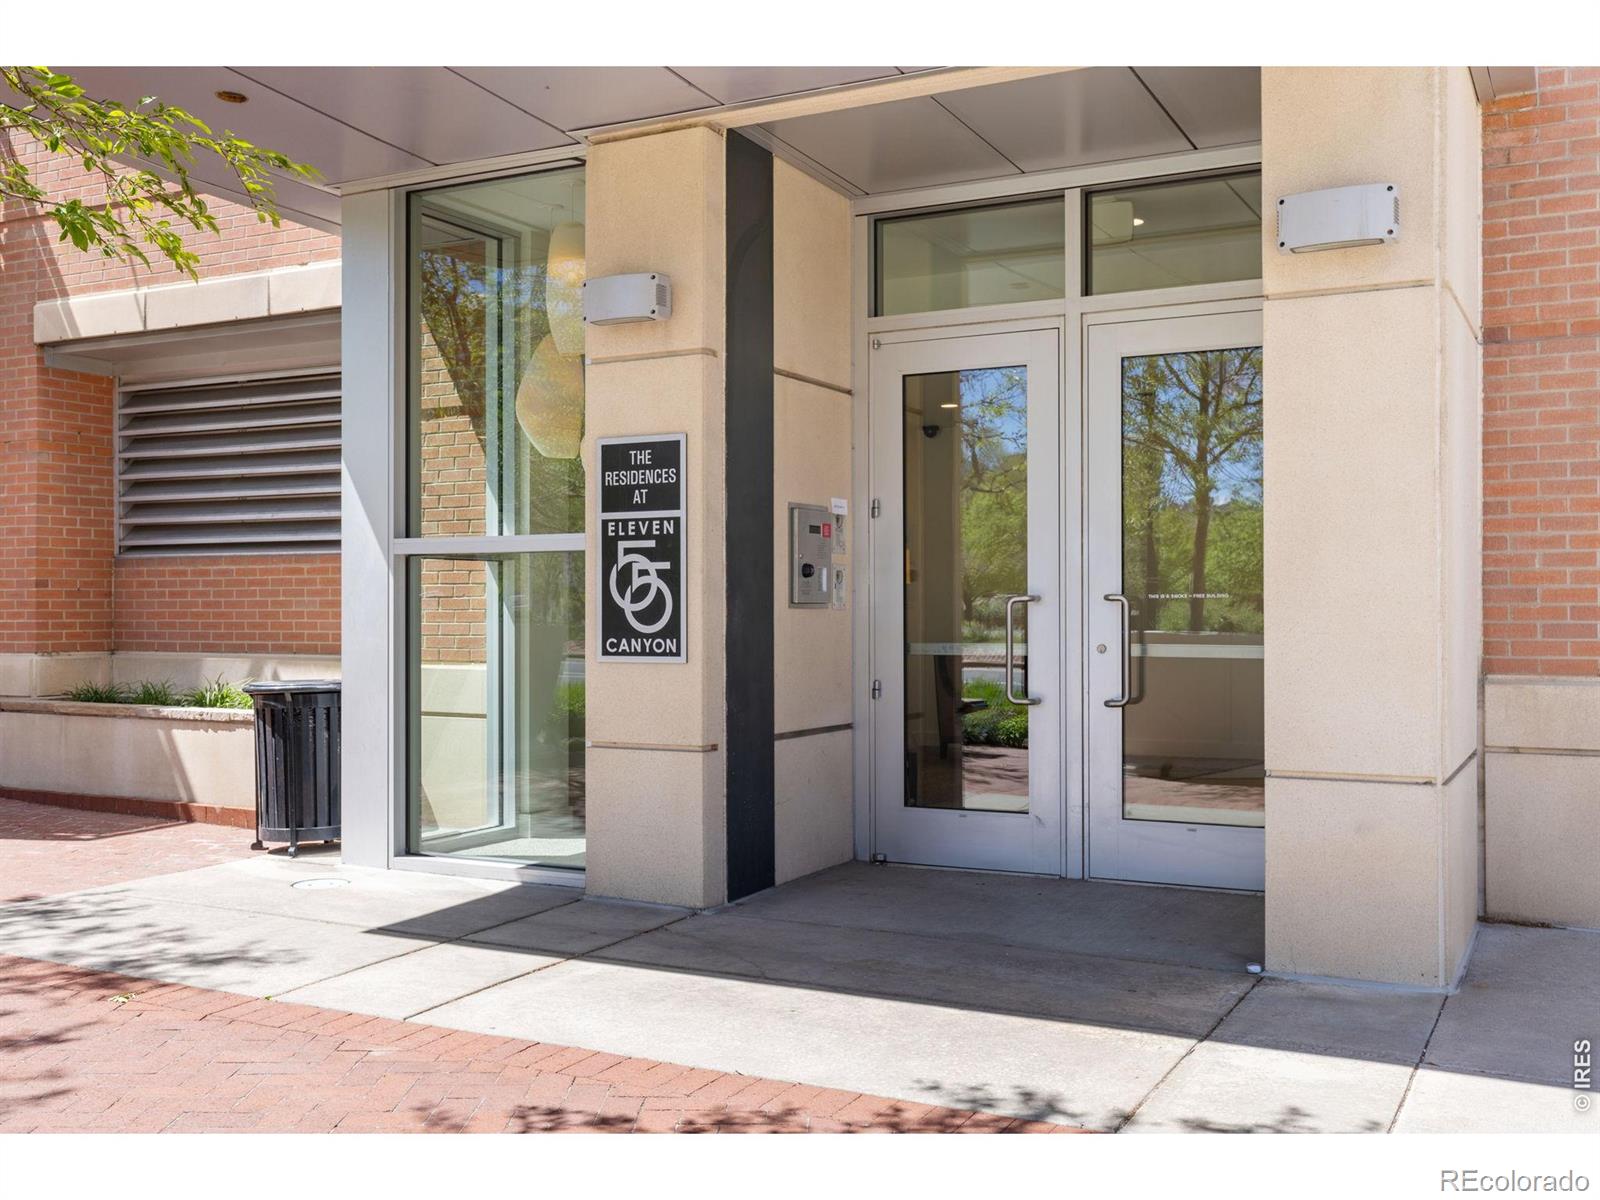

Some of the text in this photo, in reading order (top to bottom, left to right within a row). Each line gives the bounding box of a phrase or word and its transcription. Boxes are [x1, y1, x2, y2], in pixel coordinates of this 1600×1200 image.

[629, 449, 652, 465] THE
[605, 468, 677, 486] RESIDENCES
[632, 489, 648, 504] AT
[607, 520, 674, 536] ELEVEN
[609, 540, 673, 634] 55
[606, 638, 677, 653] CANYON
